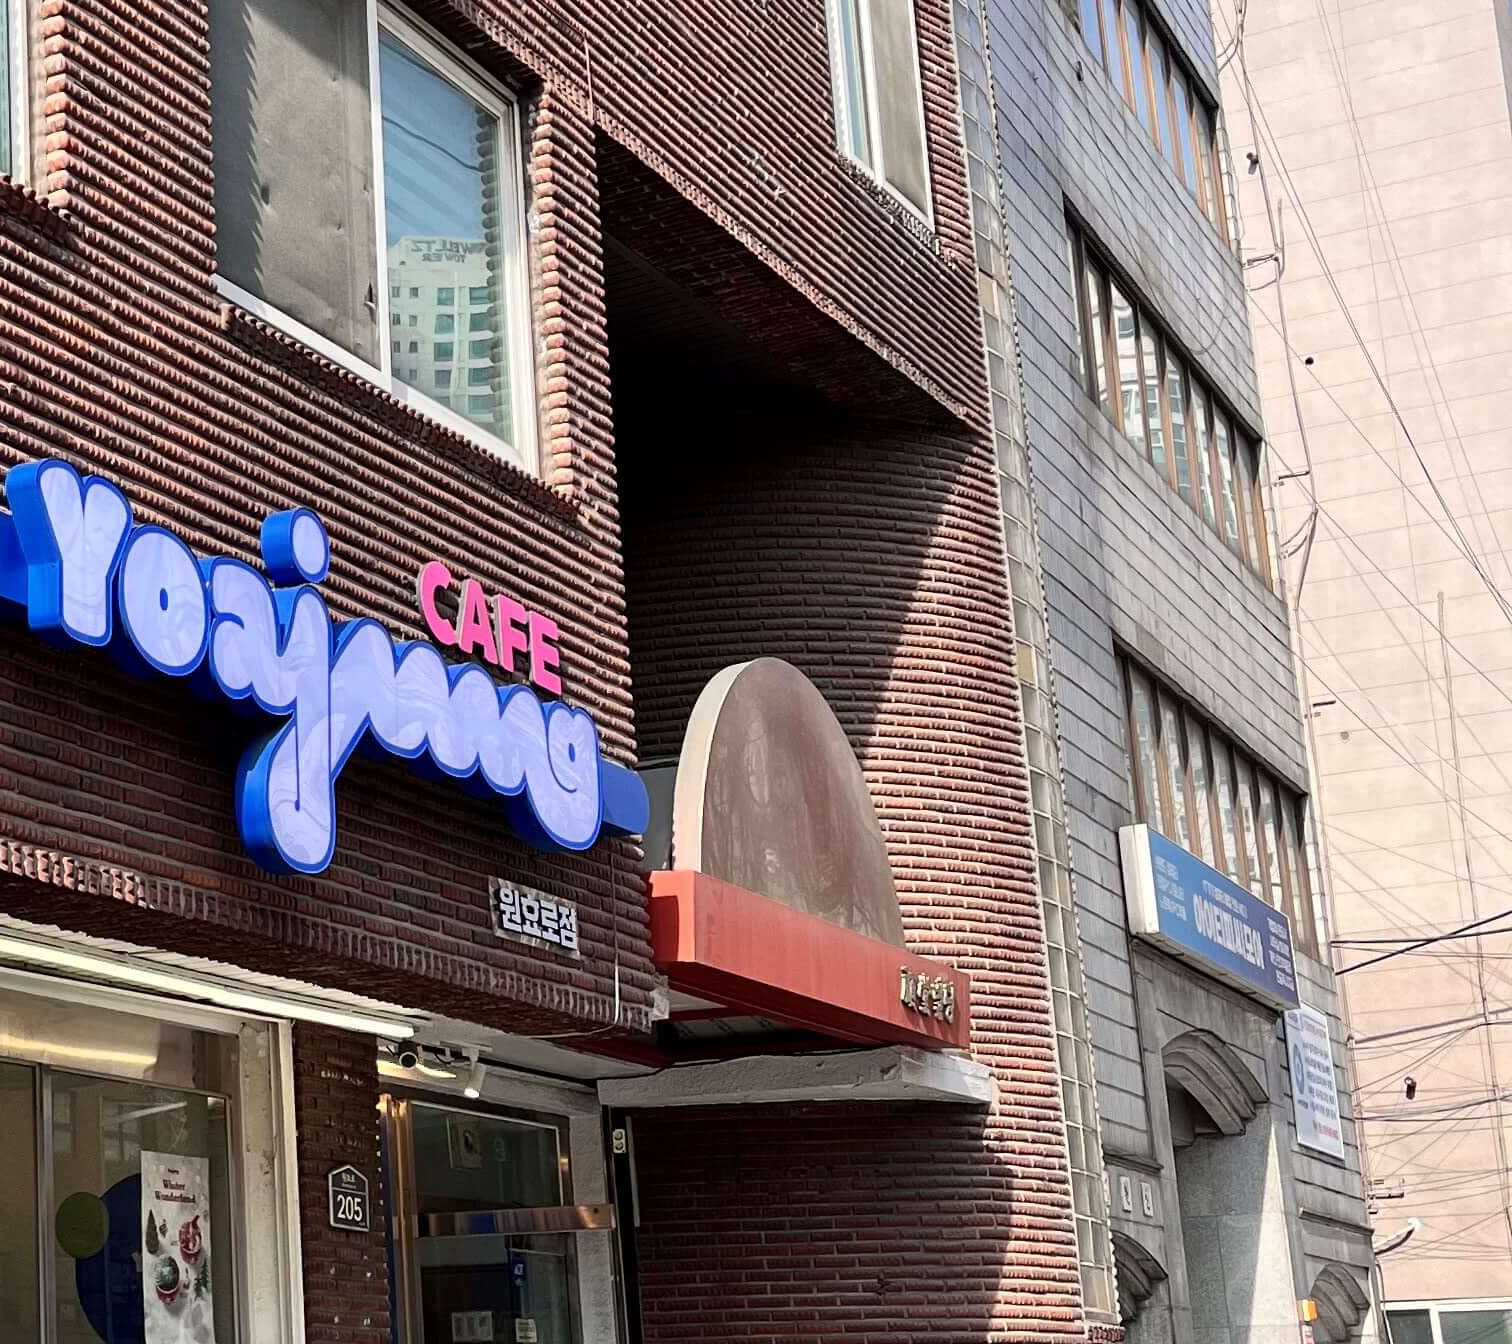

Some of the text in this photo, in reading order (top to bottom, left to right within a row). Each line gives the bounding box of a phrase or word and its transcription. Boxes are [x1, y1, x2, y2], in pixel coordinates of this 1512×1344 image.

[6, 458, 603, 874] Yoajung
[418, 560, 564, 696] CAFE
[499, 887, 578, 950] 원효로점
[337, 1194, 363, 1222] 205
